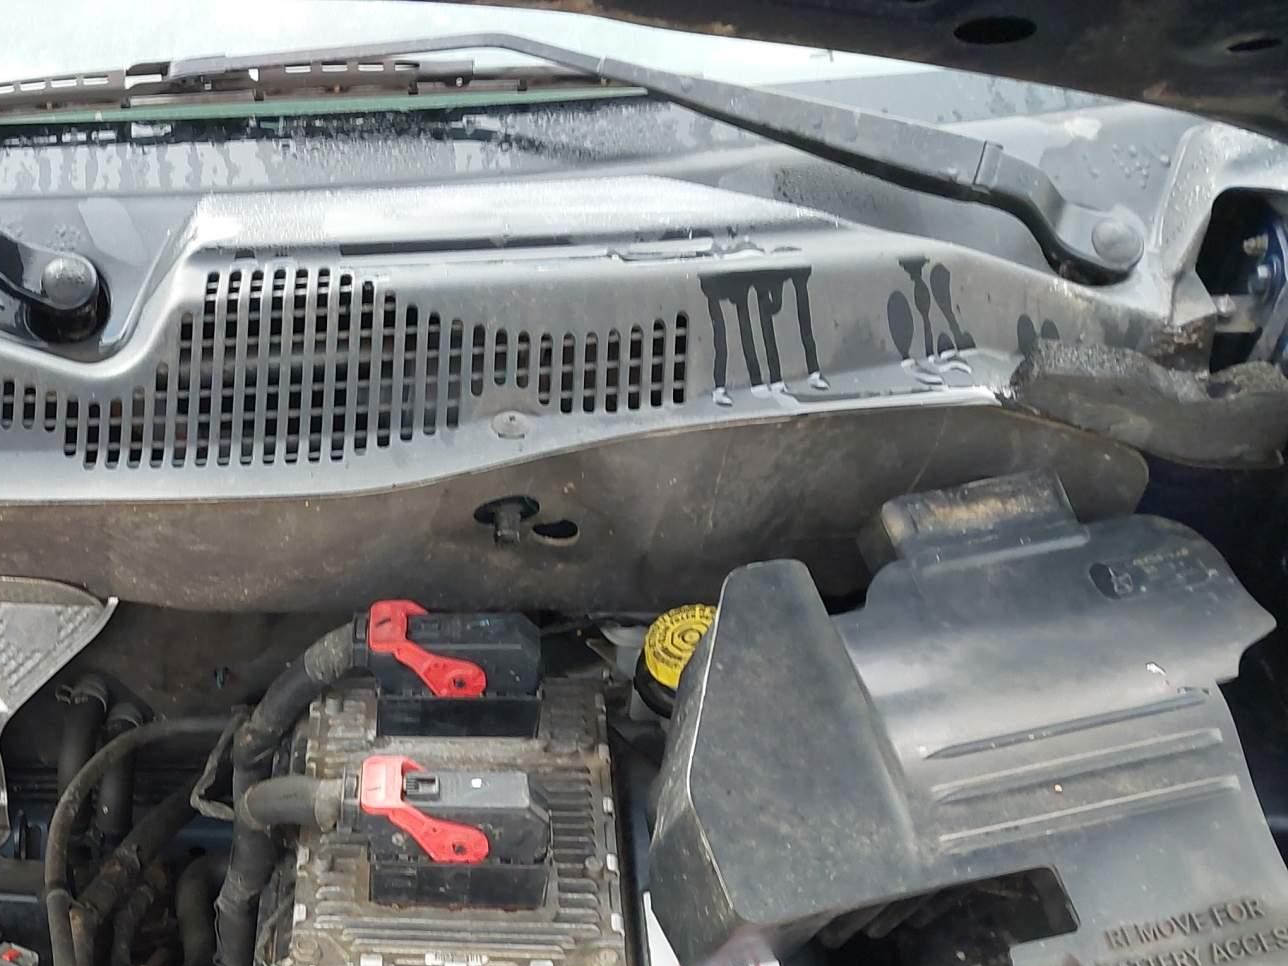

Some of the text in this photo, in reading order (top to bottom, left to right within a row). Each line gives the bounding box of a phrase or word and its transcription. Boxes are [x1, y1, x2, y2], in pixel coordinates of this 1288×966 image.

[1104, 897, 1265, 950] REMOVE FOR
[1209, 927, 1288, 965] ACCES
